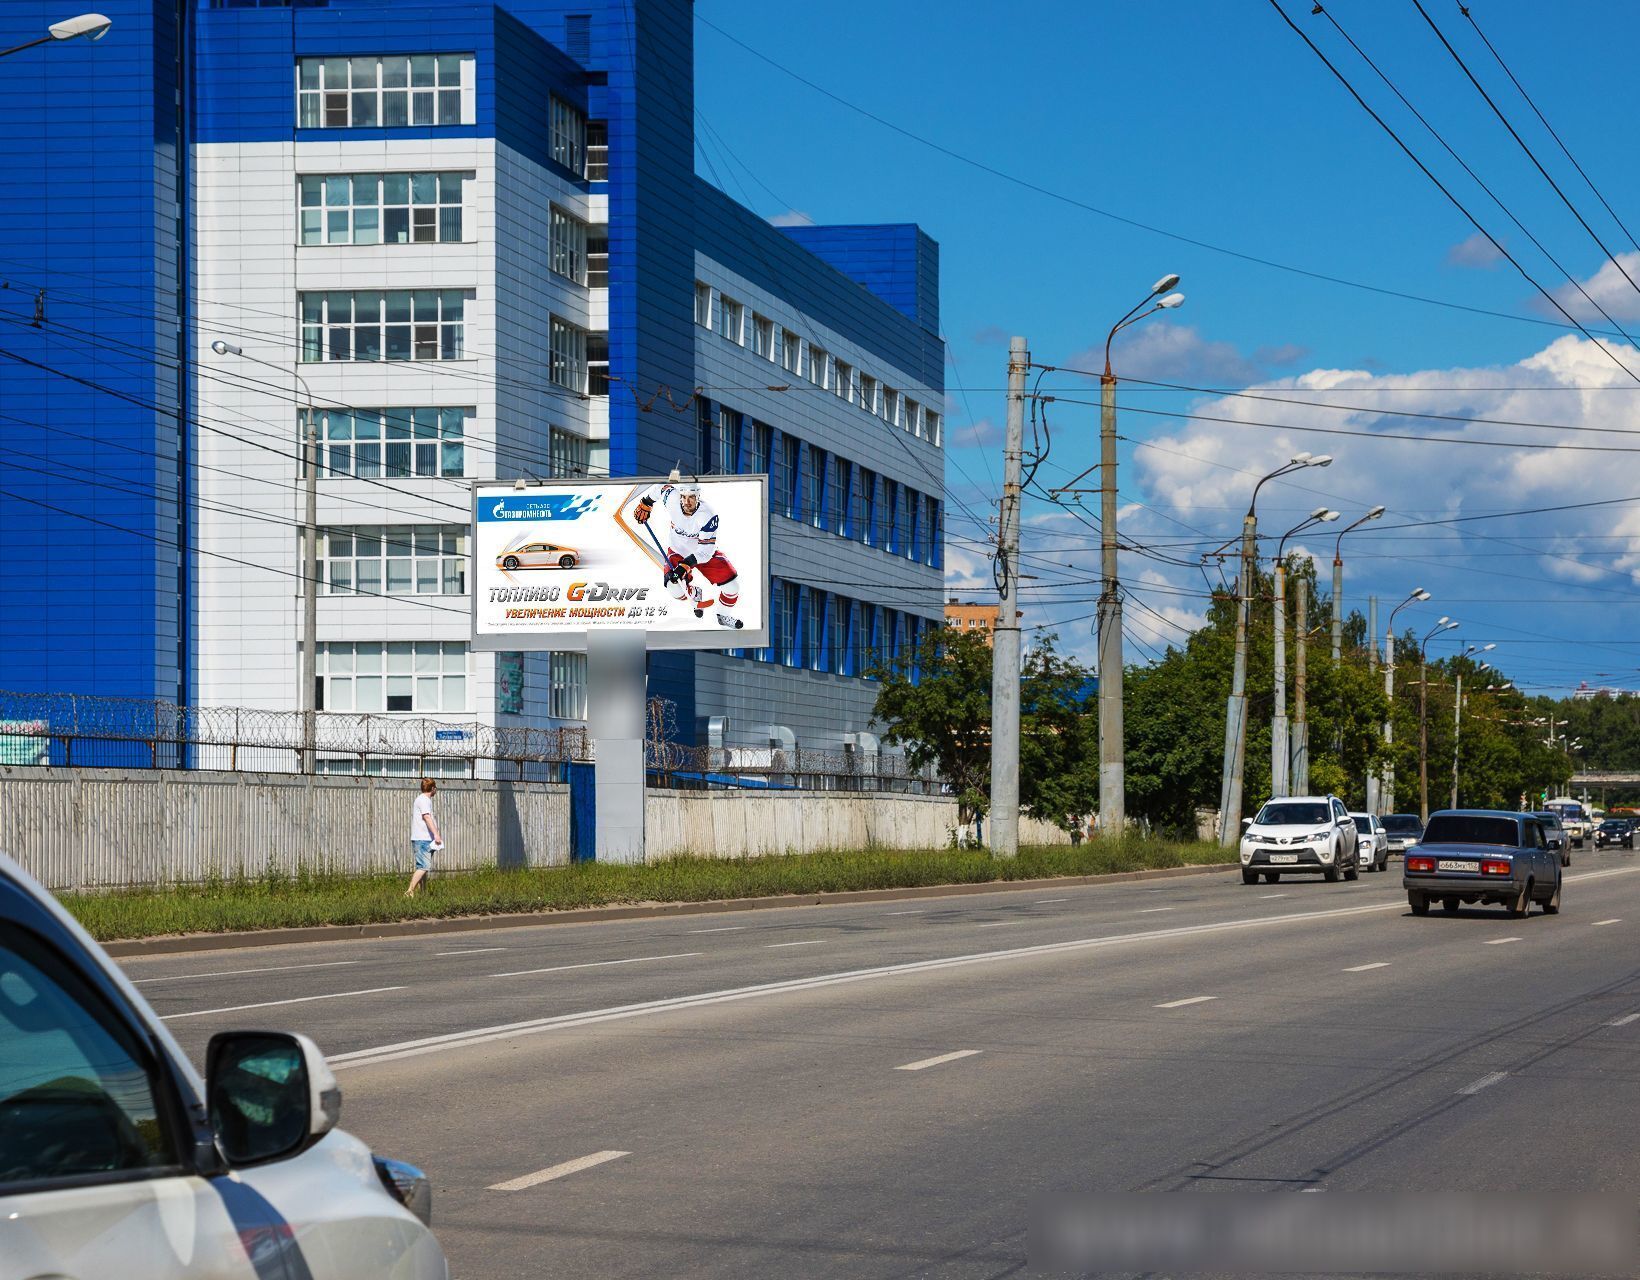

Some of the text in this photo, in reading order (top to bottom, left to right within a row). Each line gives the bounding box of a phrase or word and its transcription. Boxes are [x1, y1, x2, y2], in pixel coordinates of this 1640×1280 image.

[489, 586, 560, 602] ТОПЛИВО
[505, 605, 668, 619] УВЕЛИЧЕНИЕ МОЩНОСТИ ДО 12 %
